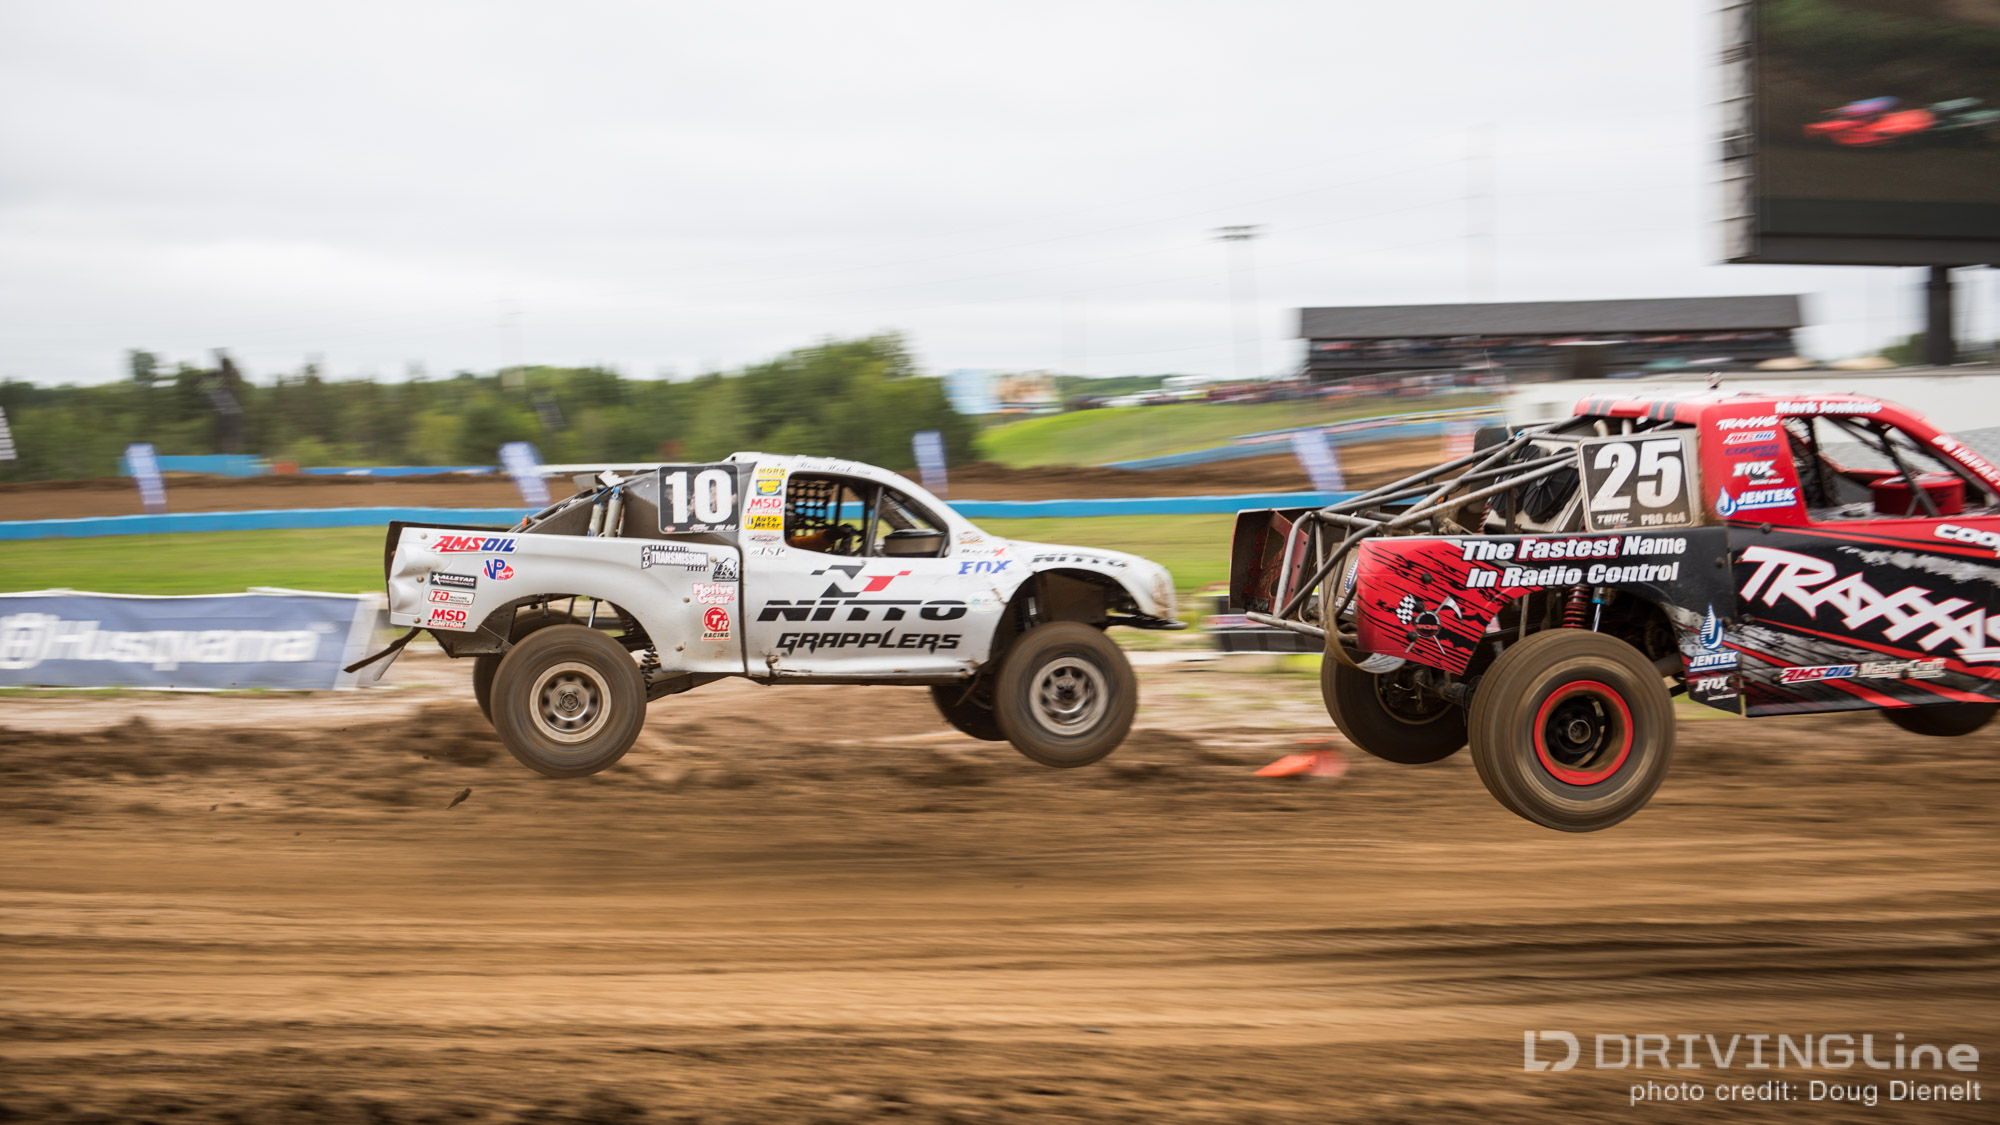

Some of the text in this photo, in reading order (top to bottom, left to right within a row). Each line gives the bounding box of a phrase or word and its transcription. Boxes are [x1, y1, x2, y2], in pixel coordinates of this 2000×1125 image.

[1775, 401, 1883, 414] Mark Jenkins
[1590, 440, 1682, 512] 25
[665, 469, 733, 524] 10
[750, 498, 782, 508] MSD
[1736, 487, 1797, 505] JENTEK
[1640, 513, 1663, 526] PRO
[431, 535, 515, 553] AMSOIL
[1462, 536, 1687, 561] The Fastest Name
[1934, 524, 2000, 557] COO
[651, 551, 708, 566] TRANSMISSION
[1032, 553, 1128, 568] NITTO
[485, 559, 506, 580] VP
[957, 560, 1013, 575] FOX
[1466, 562, 1679, 588] In Radio Control
[439, 574, 475, 583] ALLSTAR
[692, 583, 735, 596] Motive
[697, 594, 730, 605] Gear
[431, 608, 467, 622] MSD
[757, 600, 968, 622] NITTO
[429, 620, 464, 629] IGNITION
[776, 626, 962, 655] GRAPPLERS
[1690, 651, 1739, 667] JENTEK
[1782, 666, 1857, 682] AMSOIL
[1695, 676, 1730, 692] FOX
